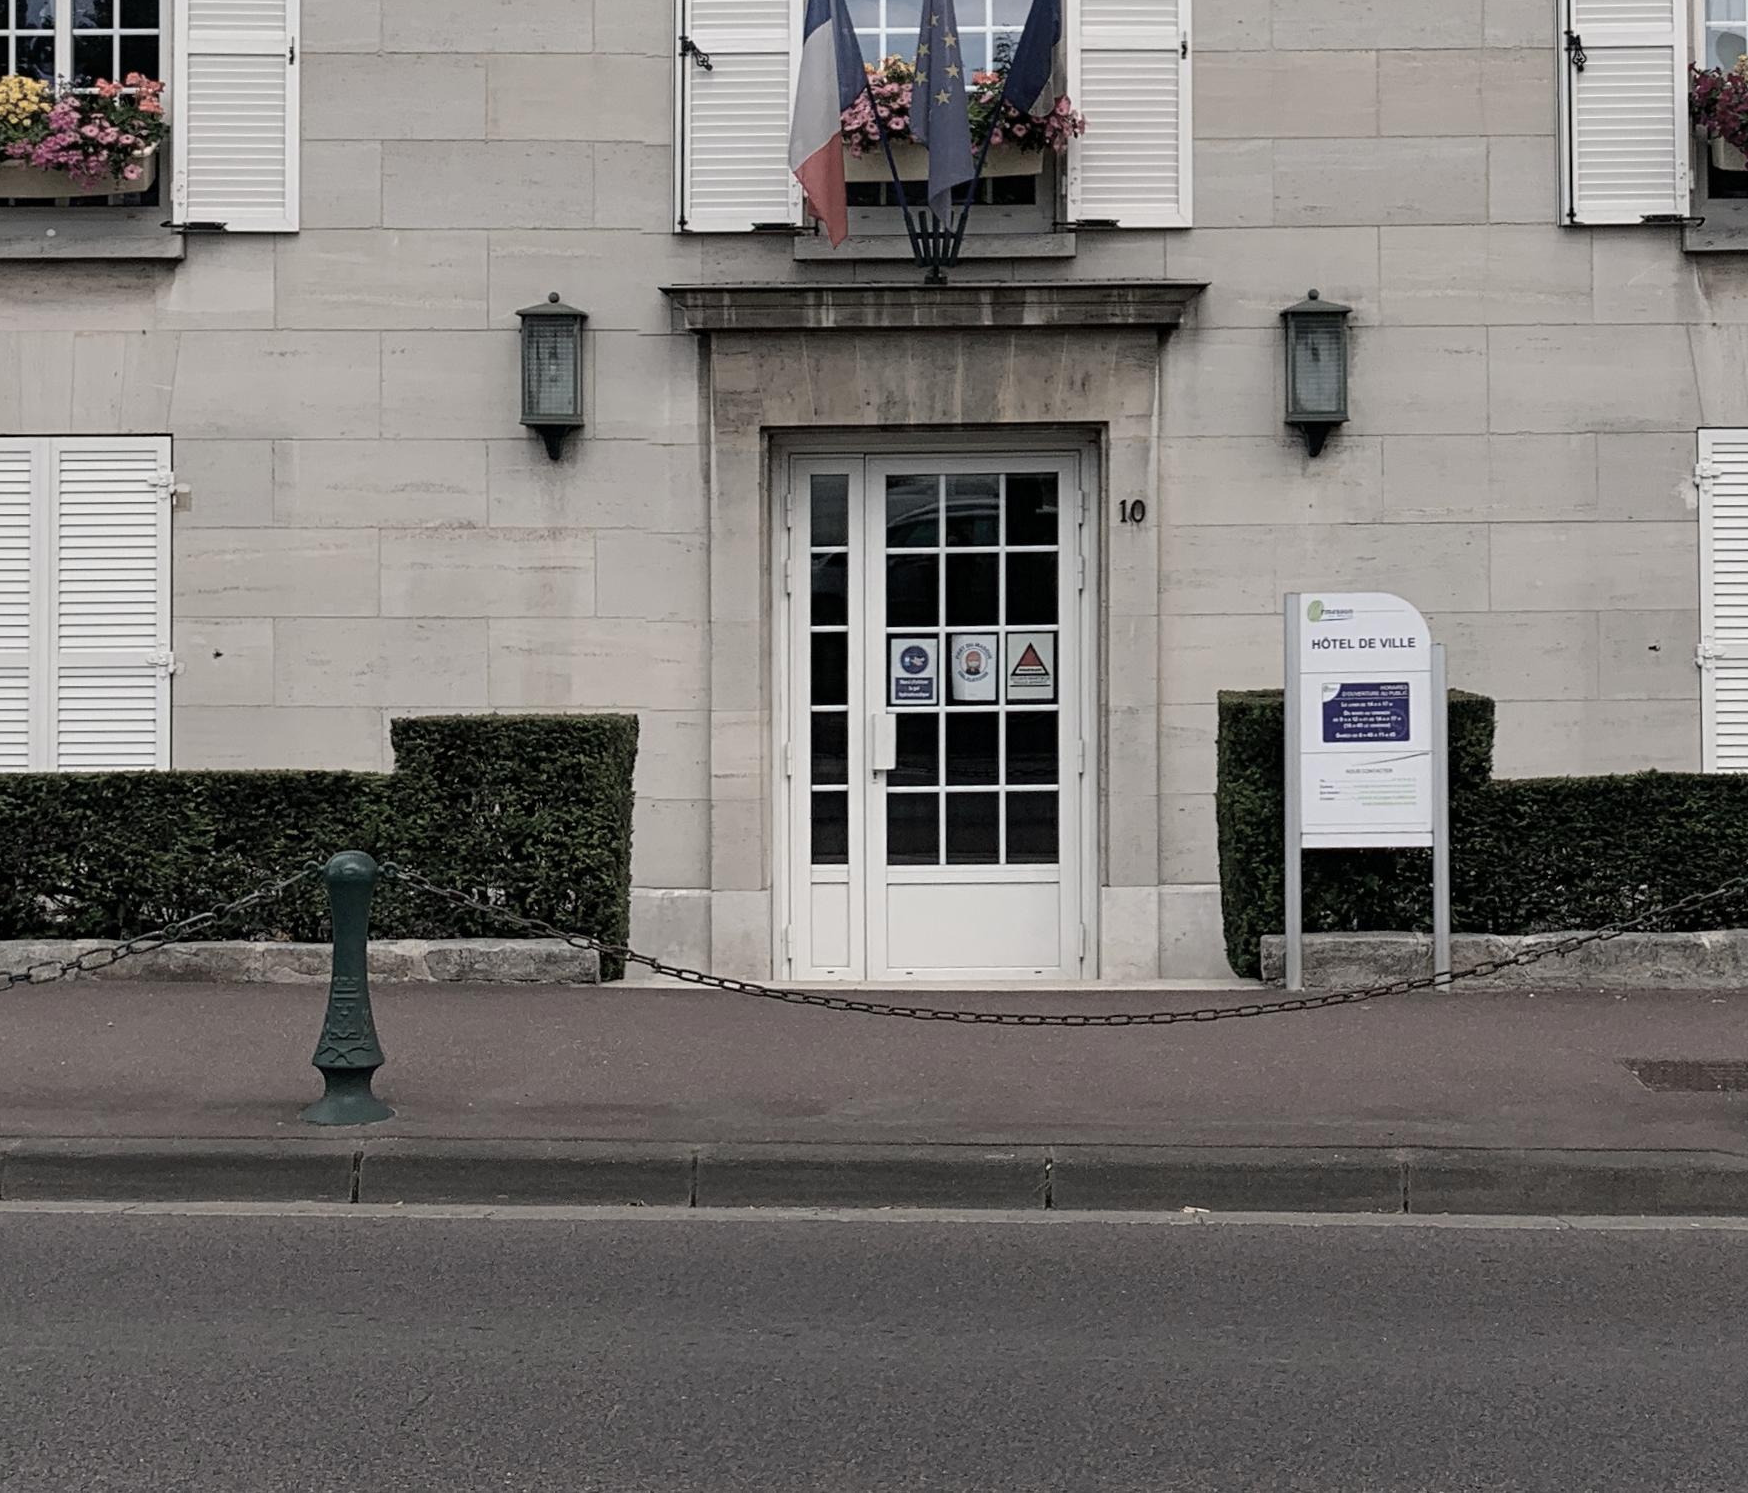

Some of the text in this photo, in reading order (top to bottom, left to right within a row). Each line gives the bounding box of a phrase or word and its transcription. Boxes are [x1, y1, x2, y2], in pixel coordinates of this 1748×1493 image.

[1119, 499, 1146, 523] 10
[1312, 637, 1416, 649] HÔTEL DE VILLE
